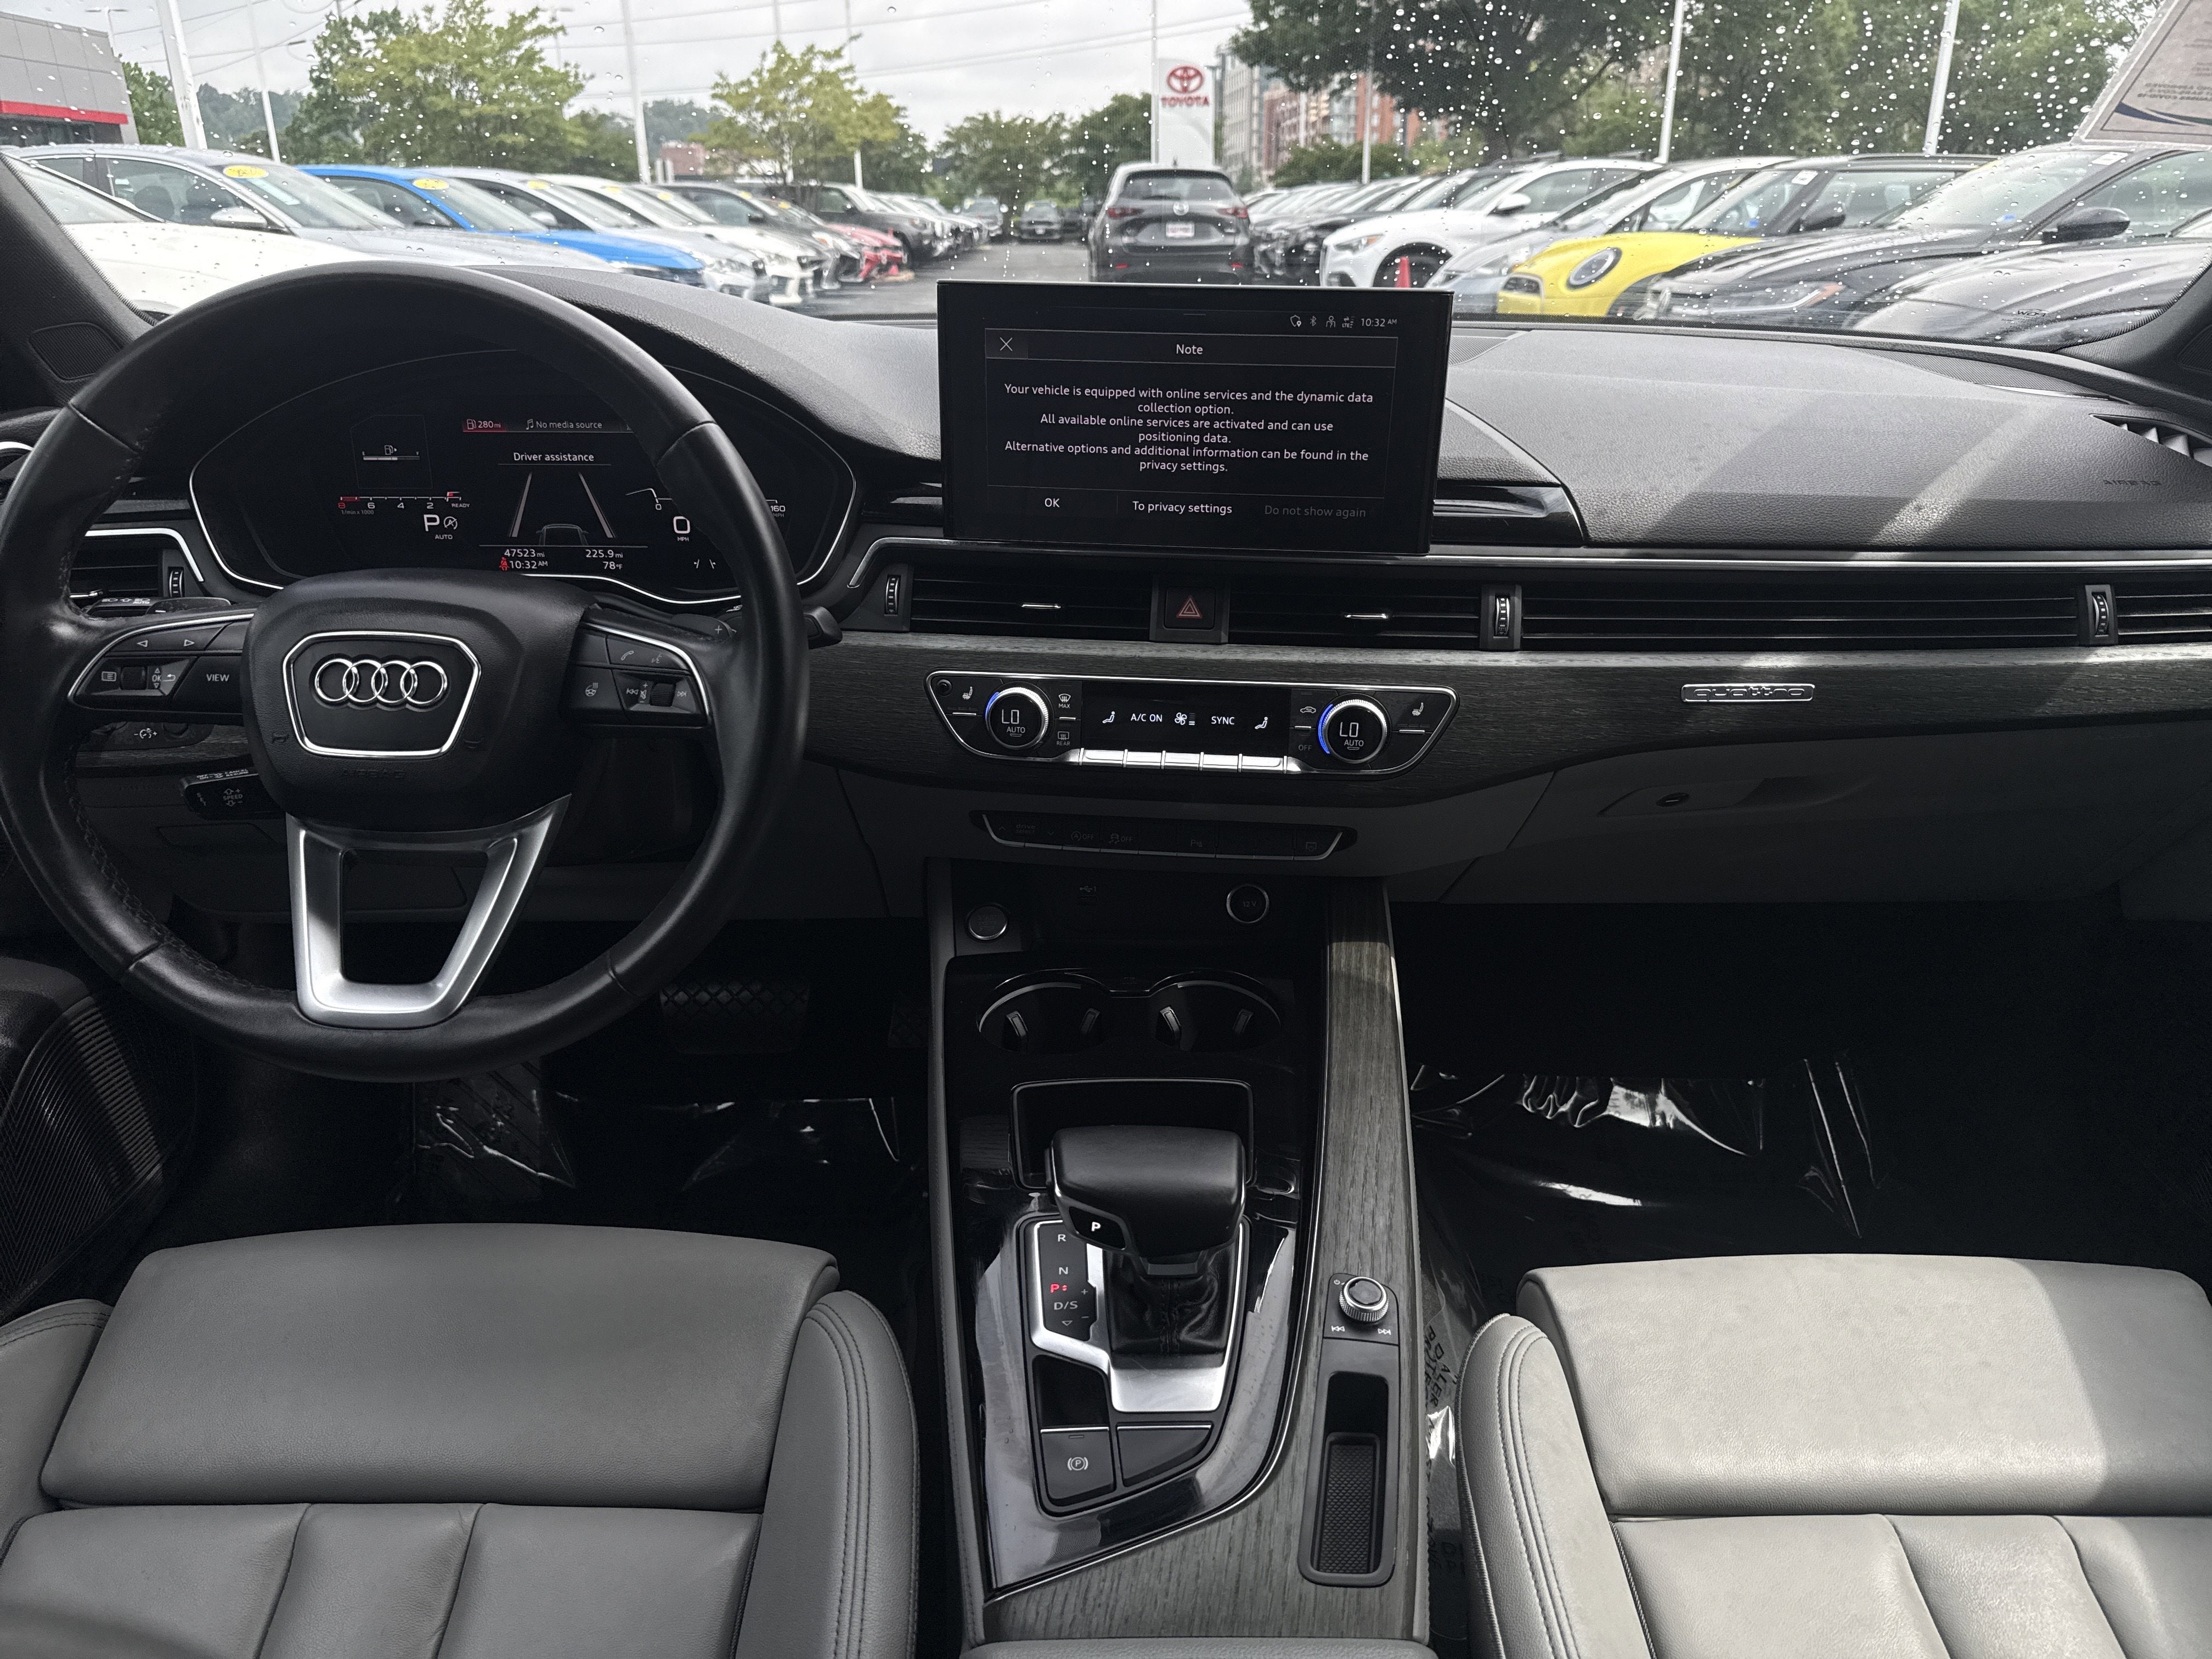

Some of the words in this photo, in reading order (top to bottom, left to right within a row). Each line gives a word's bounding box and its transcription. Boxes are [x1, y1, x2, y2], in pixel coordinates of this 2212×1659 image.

[1161, 96, 1210, 108] TOYOTA
[1361, 318, 1385, 327] 10:32
[1176, 344, 1203, 355] Note
[1004, 383, 1030, 394] Your
[1031, 385, 1070, 396] vehicle
[1073, 386, 1081, 396] is
[1084, 386, 1135, 399] equipped
[1138, 388, 1163, 398] with
[1166, 388, 1200, 399] online
[1203, 390, 1248, 400] services
[1251, 390, 1272, 400] and
[1275, 390, 1294, 401] the
[1297, 391, 1345, 404] dynamic
[1347, 392, 1373, 403] data
[1138, 402, 1191, 413] collection
[1194, 404, 1234, 416] option.
[1040, 413, 1056, 424] All
[1058, 414, 1107, 425] available
[1109, 416, 1143, 426] online
[1146, 417, 1190, 428] services
[1193, 420, 1210, 428] are
[1213, 419, 1264, 430] activated
[1267, 420, 1288, 430] and
[1291, 422, 1311, 431] can
[1314, 423, 1333, 431] use
[1138, 431, 1200, 445] positioning
[1203, 432, 1231, 443] data.
[514, 452, 543, 461] Driver
[545, 453, 594, 461] assistance
[1005, 441, 1064, 453] Alternative
[1068, 443, 1108, 455] options
[1111, 444, 1131, 455] and
[1134, 445, 1190, 456] additional
[1193, 447, 1258, 458] information
[1284, 449, 1297, 459] be
[1300, 449, 1333, 460] found
[1336, 450, 1346, 460] in
[1350, 450, 1369, 461] the
[1139, 460, 1178, 472] privacy
[1181, 461, 1228, 474] settings.
[1045, 498, 1060, 507] OK
[1132, 501, 1145, 511] To
[1148, 504, 1186, 515] privacy
[1188, 503, 1232, 515] settings
[1265, 505, 1279, 515] Do
[1283, 506, 1301, 516] not
[1304, 506, 1333, 516] show
[1335, 509, 1366, 519] again
[423, 514, 440, 532] P
[151, 674, 162, 682] OK
[206, 674, 230, 682] VIEW
[1694, 686, 1805, 702] quattro
[1130, 713, 1147, 722] A/C
[1149, 714, 1163, 723] ON
[1211, 716, 1235, 725] SYNC
[1006, 725, 1026, 733] AUTO
[1344, 738, 1365, 747] AUTO
[1091, 1221, 1101, 1232] P
[1058, 1234, 1066, 1242] R
[1059, 1267, 1068, 1275] N
[1054, 1301, 1078, 1310] D/S
